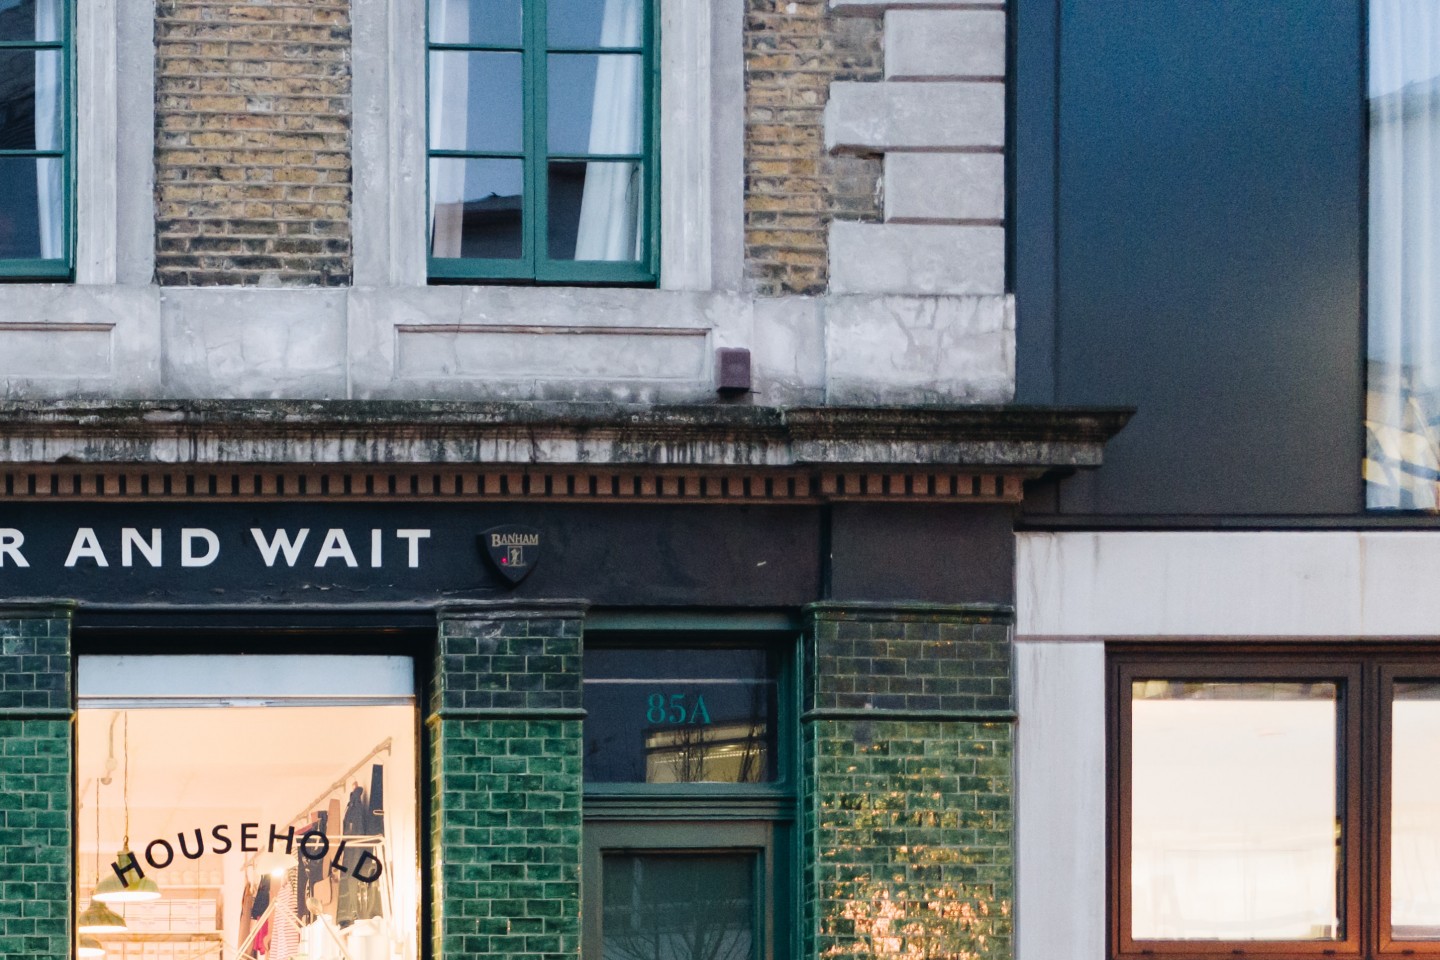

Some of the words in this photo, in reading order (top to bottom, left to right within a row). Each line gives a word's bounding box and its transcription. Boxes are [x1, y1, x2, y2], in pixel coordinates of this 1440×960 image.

[63, 527, 221, 568] AND
[250, 527, 431, 568] WAIT
[491, 532, 539, 547] BANHAM
[646, 693, 711, 724] 85A
[111, 822, 384, 889] HOUSEHOLD
